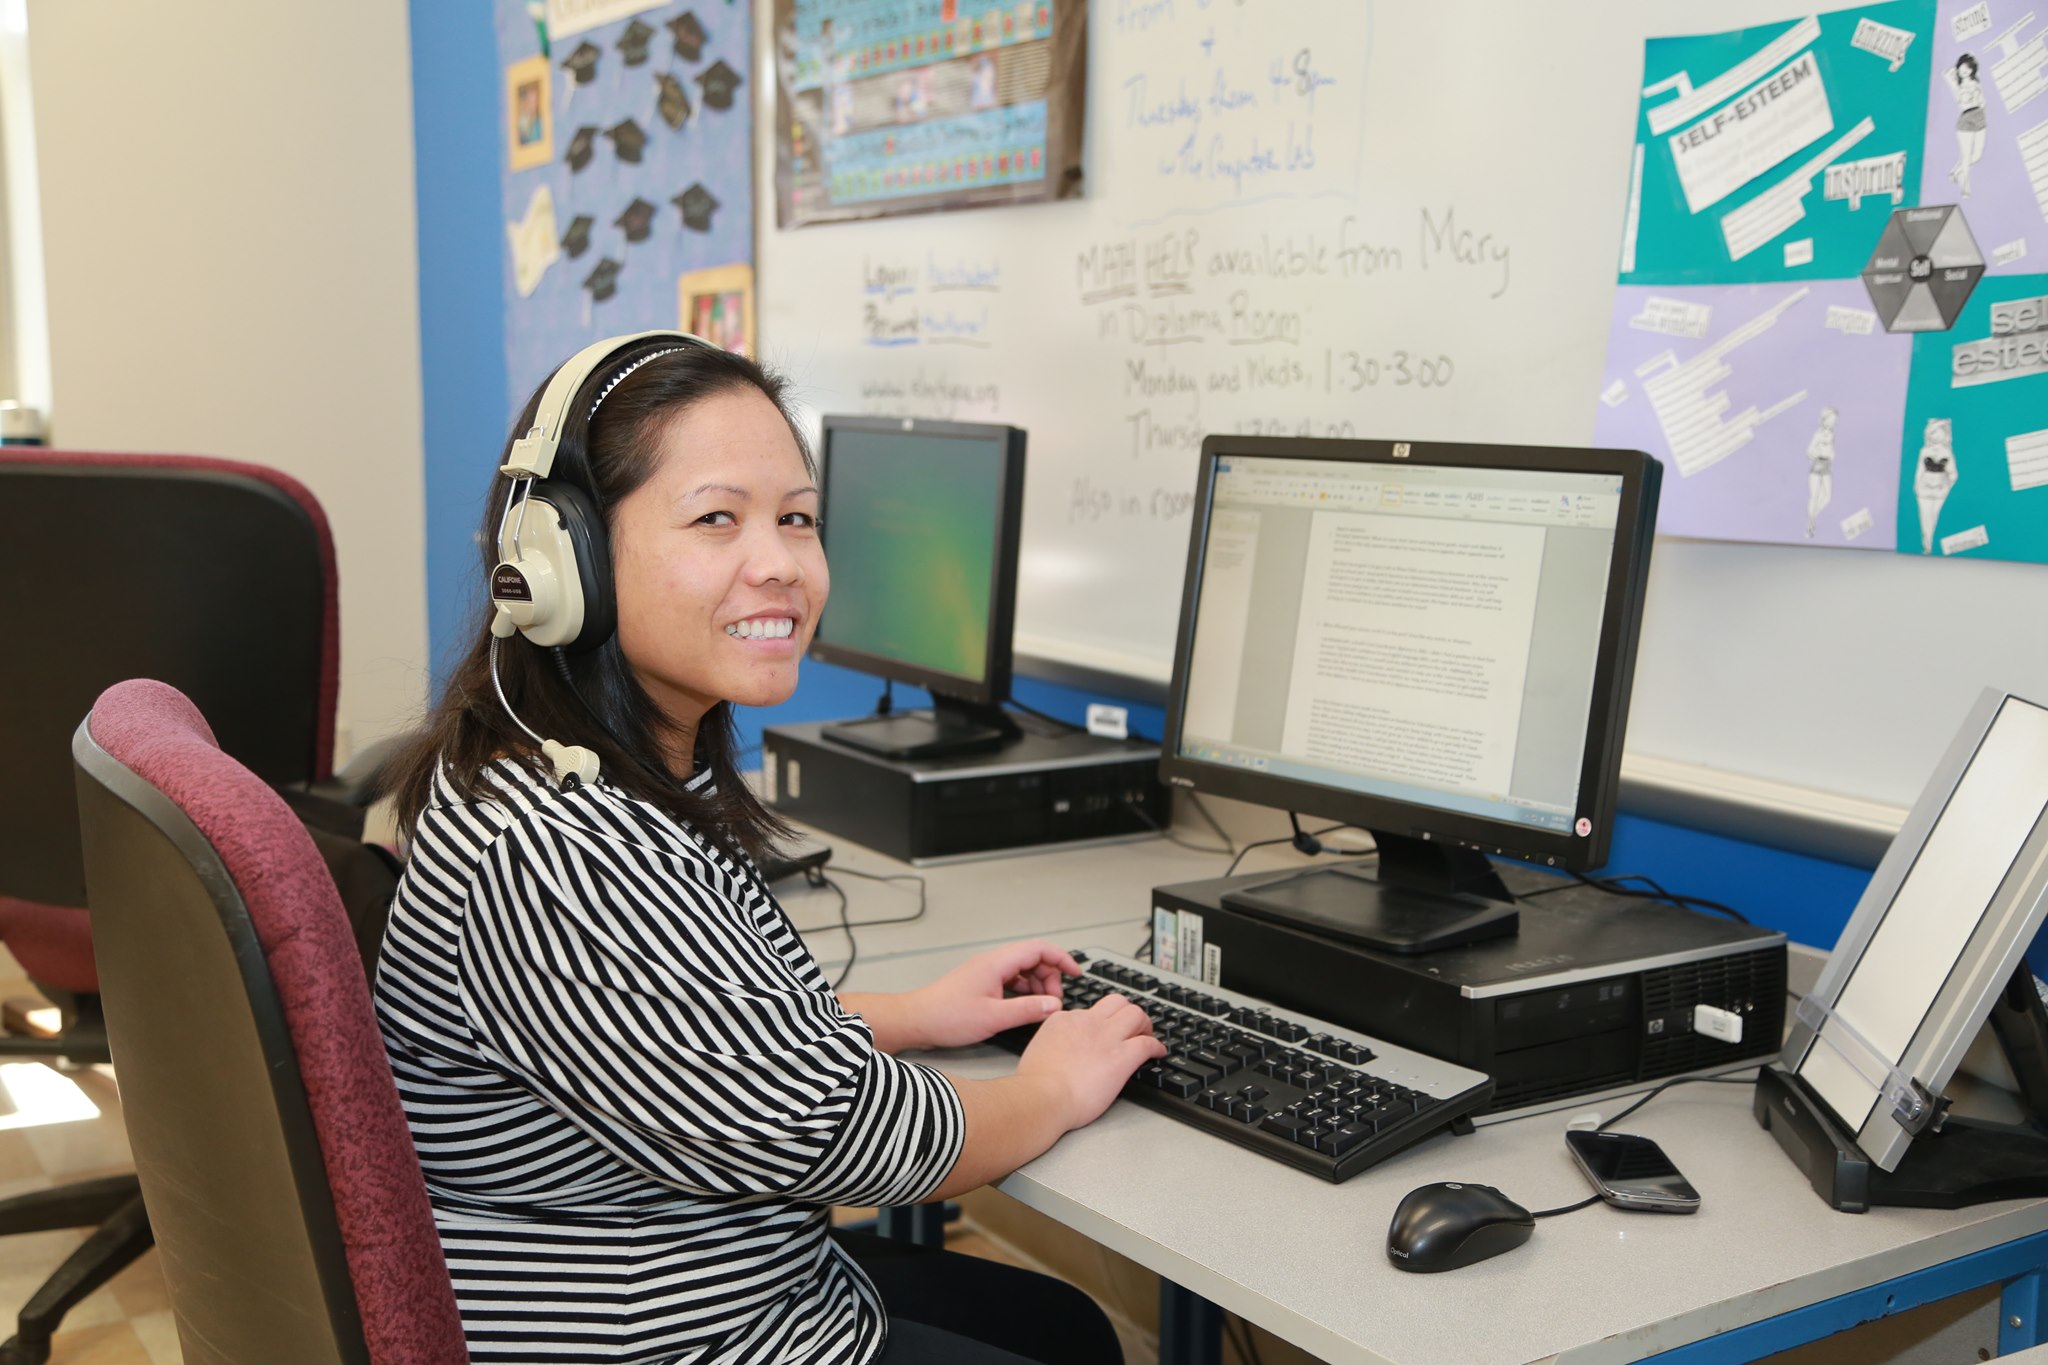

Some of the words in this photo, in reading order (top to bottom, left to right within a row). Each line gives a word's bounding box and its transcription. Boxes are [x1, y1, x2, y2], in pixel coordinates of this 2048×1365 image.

[1678, 59, 1812, 153] SELF-ESTEEM
[1077, 242, 1138, 289] MATH
[1145, 229, 1200, 284] HELP
[1208, 231, 1330, 278] available
[1335, 215, 1402, 279] from
[1420, 207, 1511, 299] Mary
[1910, 259, 1931, 279] Self
[1124, 303, 1223, 361] Diploma
[1992, 299, 2048, 338] sel
[1125, 357, 1201, 419] Monday
[1206, 364, 1242, 393] and
[497, 576, 522, 584] CALIFONE
[1390, 1246, 1410, 1259] Optical
